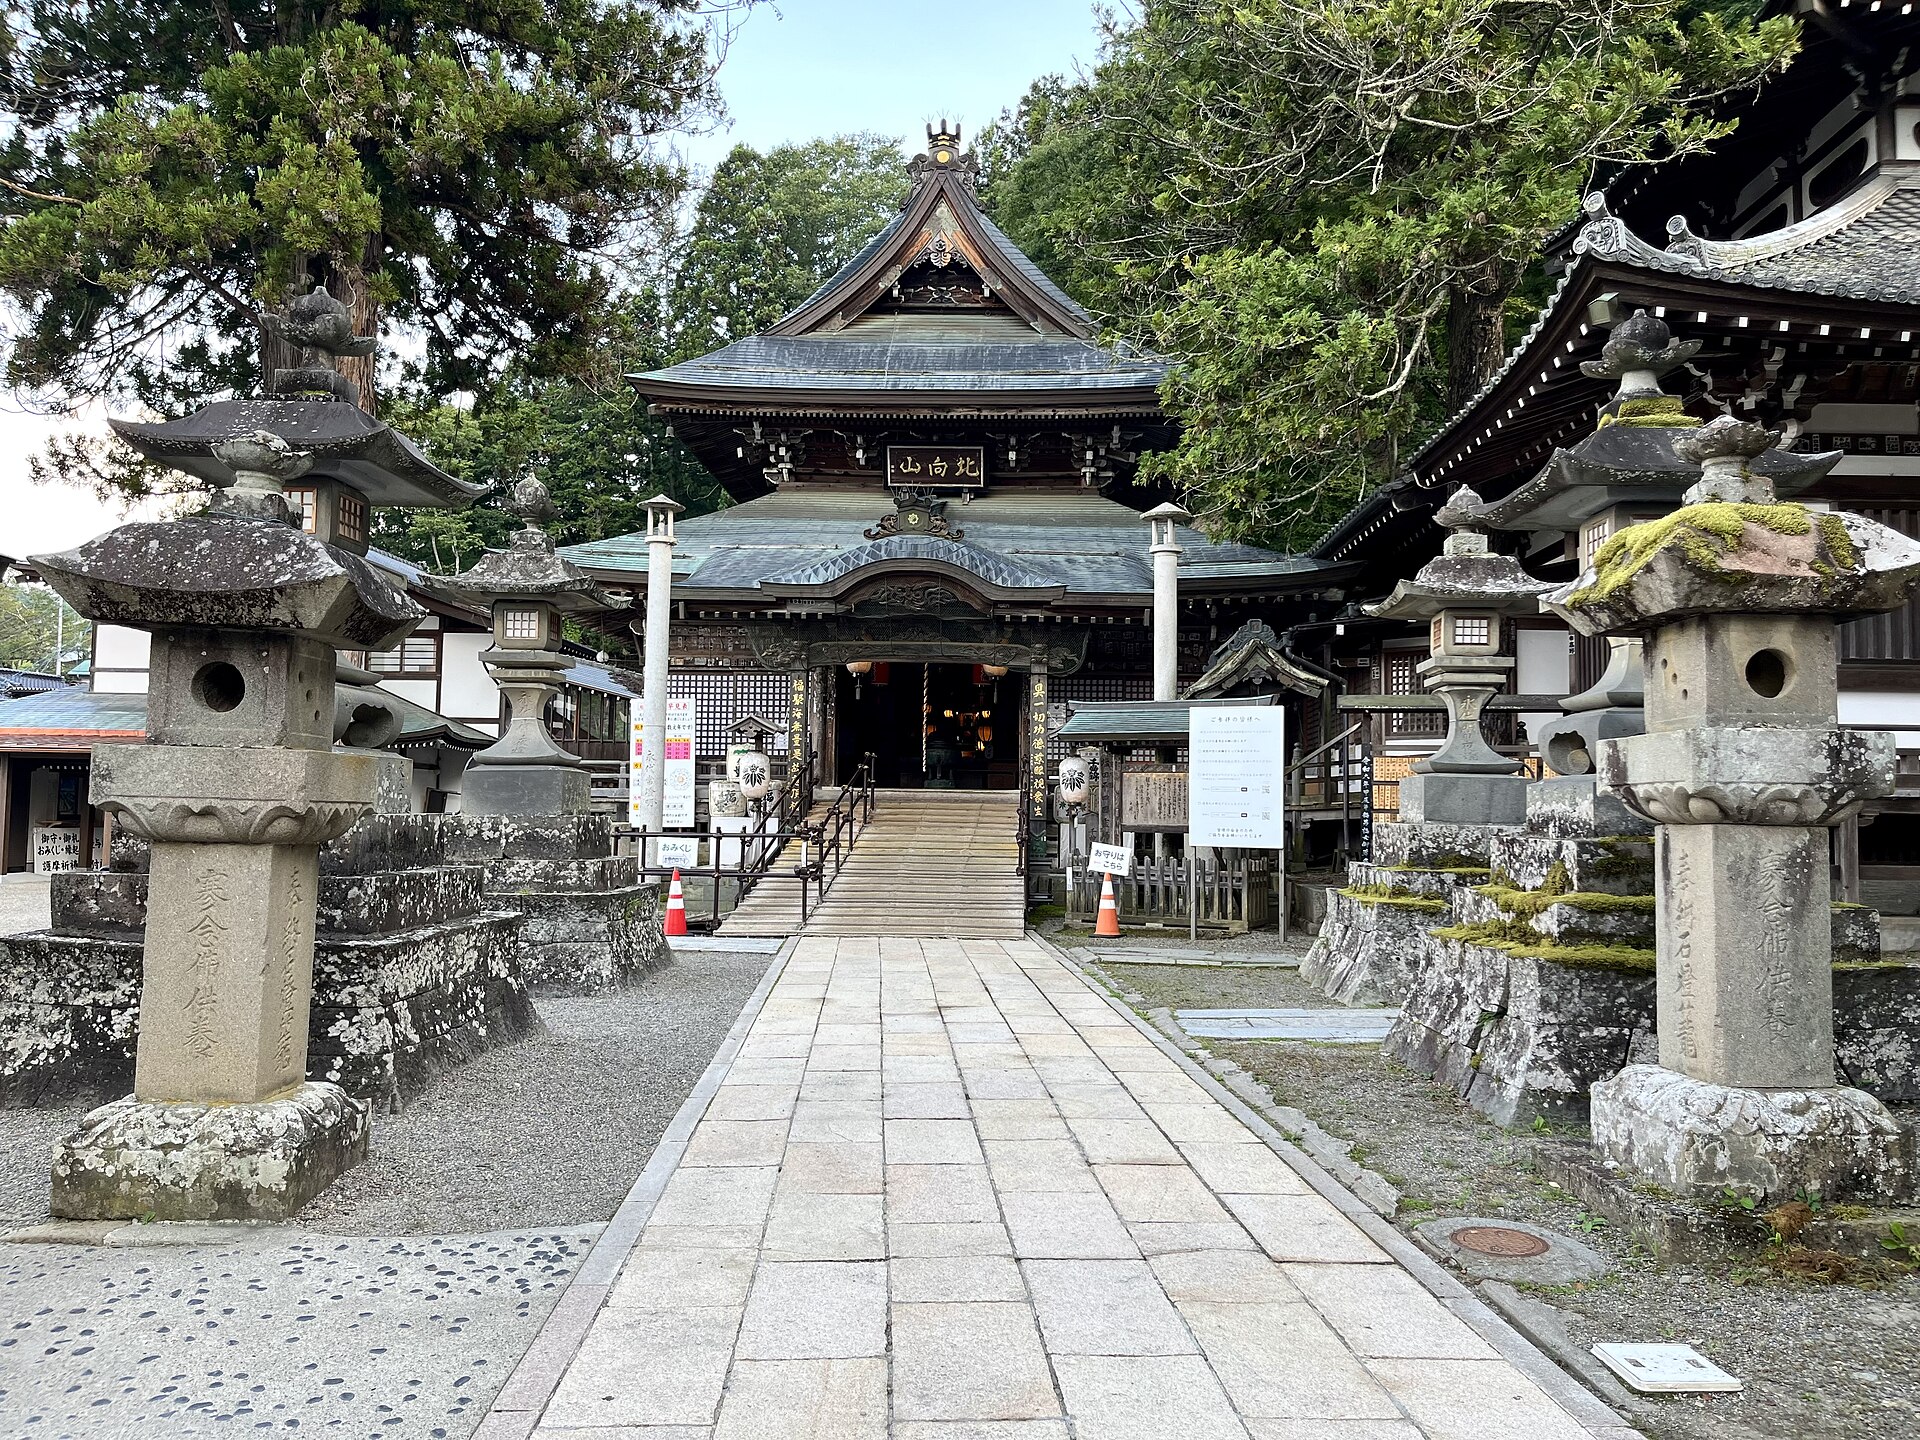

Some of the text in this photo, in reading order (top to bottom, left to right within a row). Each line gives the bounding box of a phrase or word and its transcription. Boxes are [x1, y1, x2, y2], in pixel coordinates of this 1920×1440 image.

[899, 456, 980, 477] 北向山
[662, 843, 692, 853] おみくじ
[1095, 849, 1125, 861] お守りは
[1103, 860, 1123, 871] こちら
